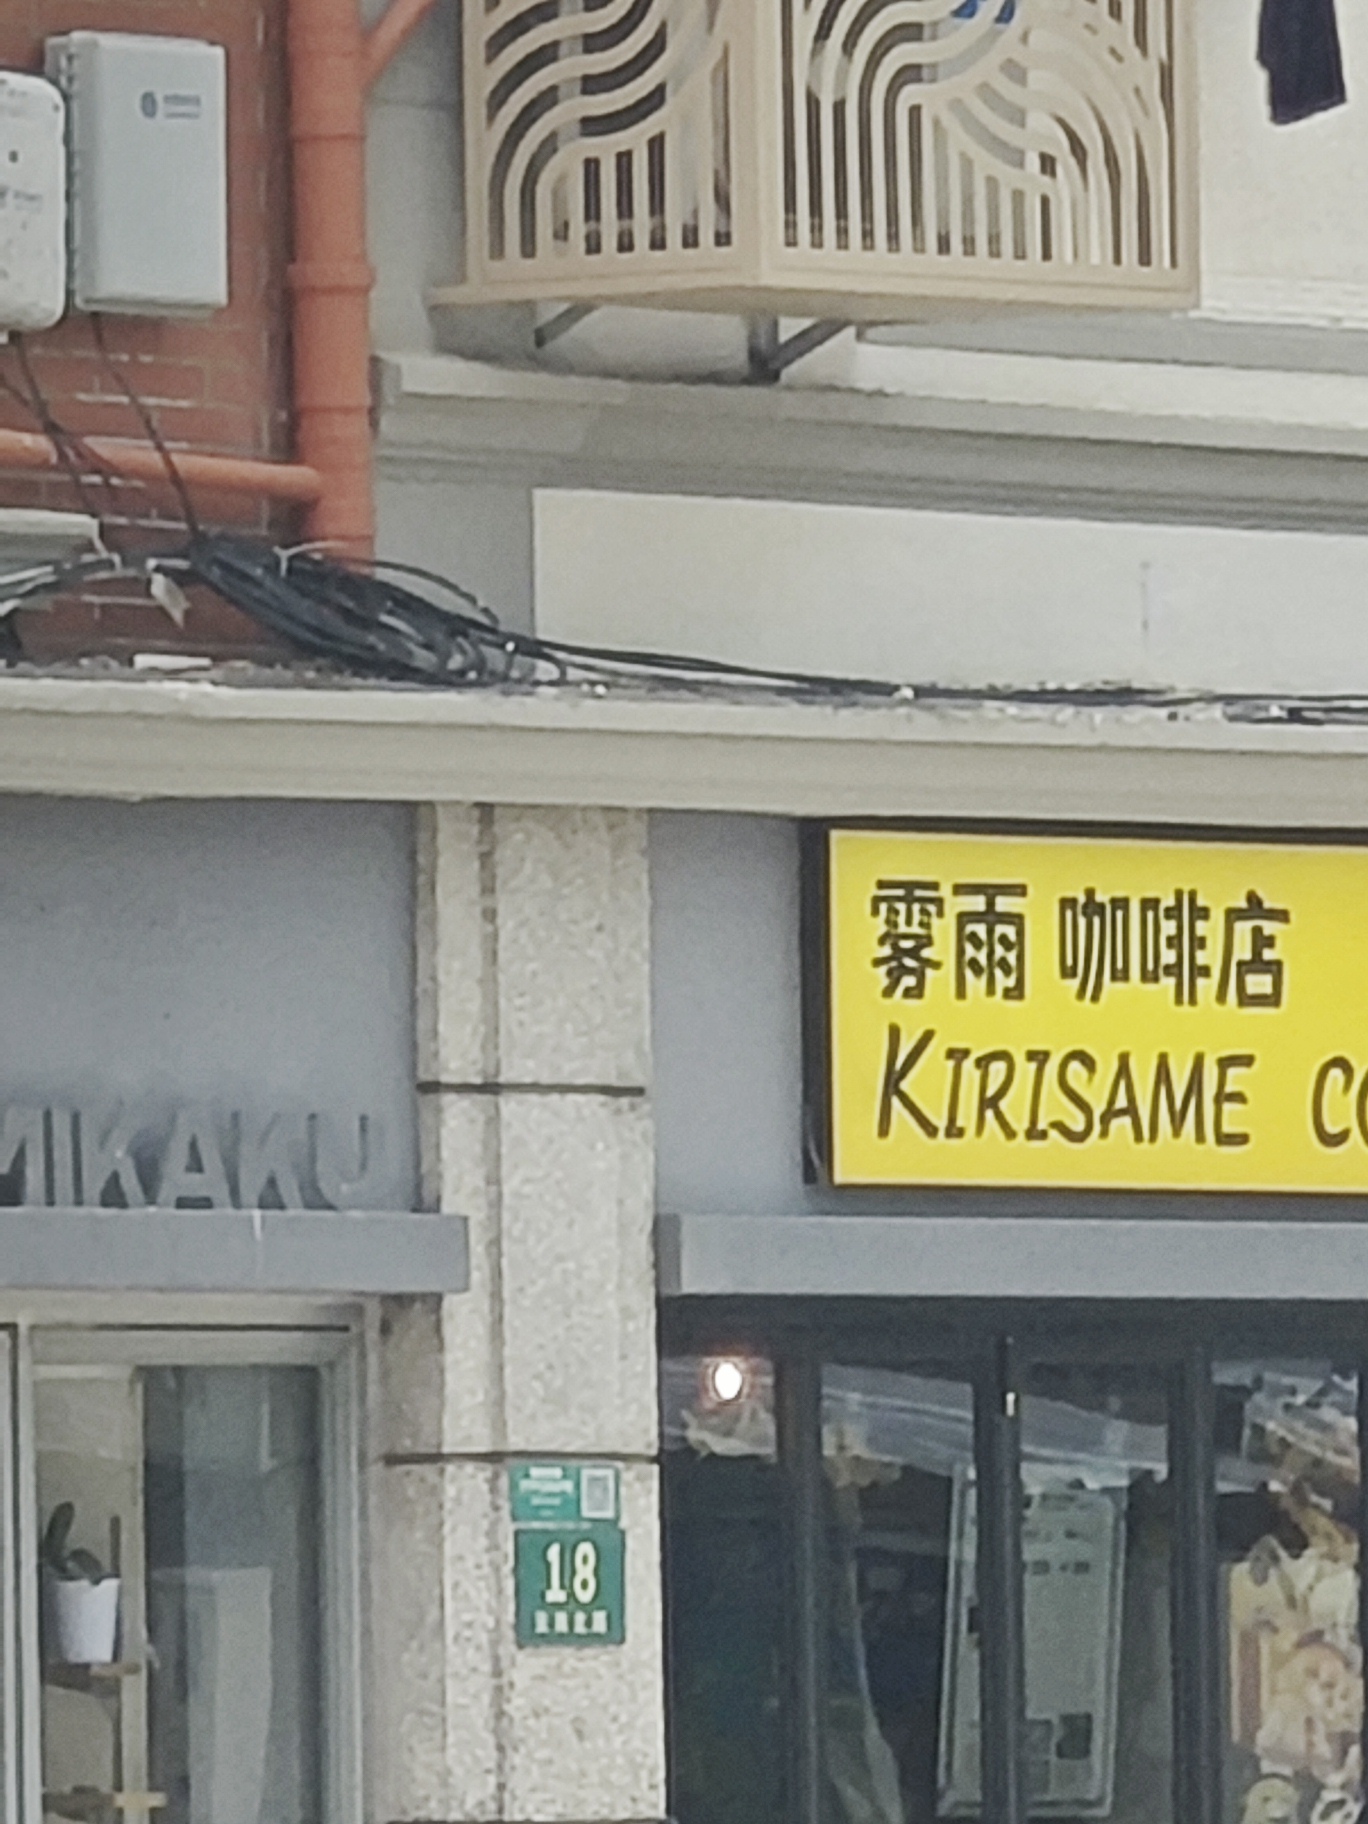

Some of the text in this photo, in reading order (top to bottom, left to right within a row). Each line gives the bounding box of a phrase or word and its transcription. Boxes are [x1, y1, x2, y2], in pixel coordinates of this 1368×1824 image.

[870, 879, 1291, 1009] 雾雨 咖啡店
[877, 1022, 1256, 1146] KIRISAME
[544, 1540, 597, 1604] 18
